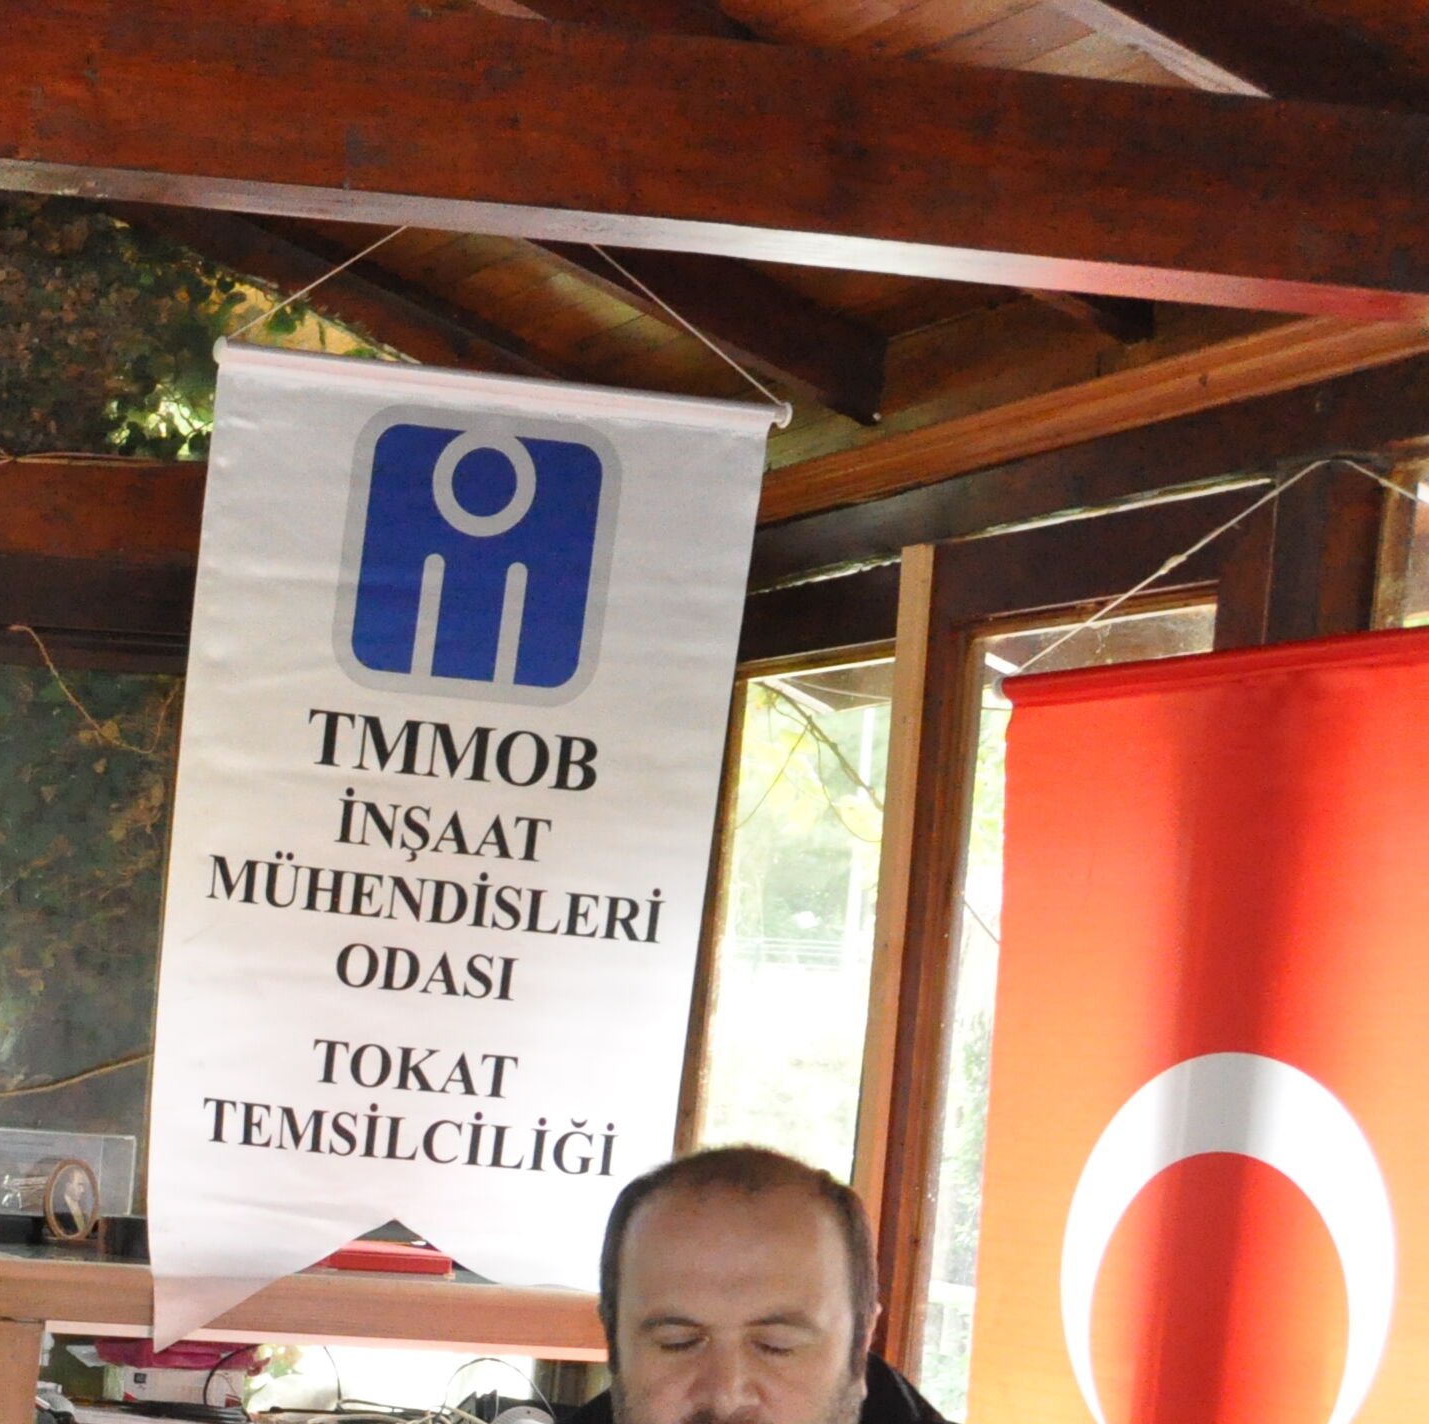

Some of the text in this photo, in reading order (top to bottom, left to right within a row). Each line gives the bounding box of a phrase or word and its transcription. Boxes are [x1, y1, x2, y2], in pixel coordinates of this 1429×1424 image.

[308, 707, 599, 794] TMMOB
[332, 787, 553, 863] İNŞAAT
[205, 851, 665, 944] MÜHENDİSLERİ
[334, 941, 520, 1003] ODASI
[311, 1037, 519, 1100] TOKAT
[203, 1097, 619, 1178] TEMSİLCİLİĞİ
